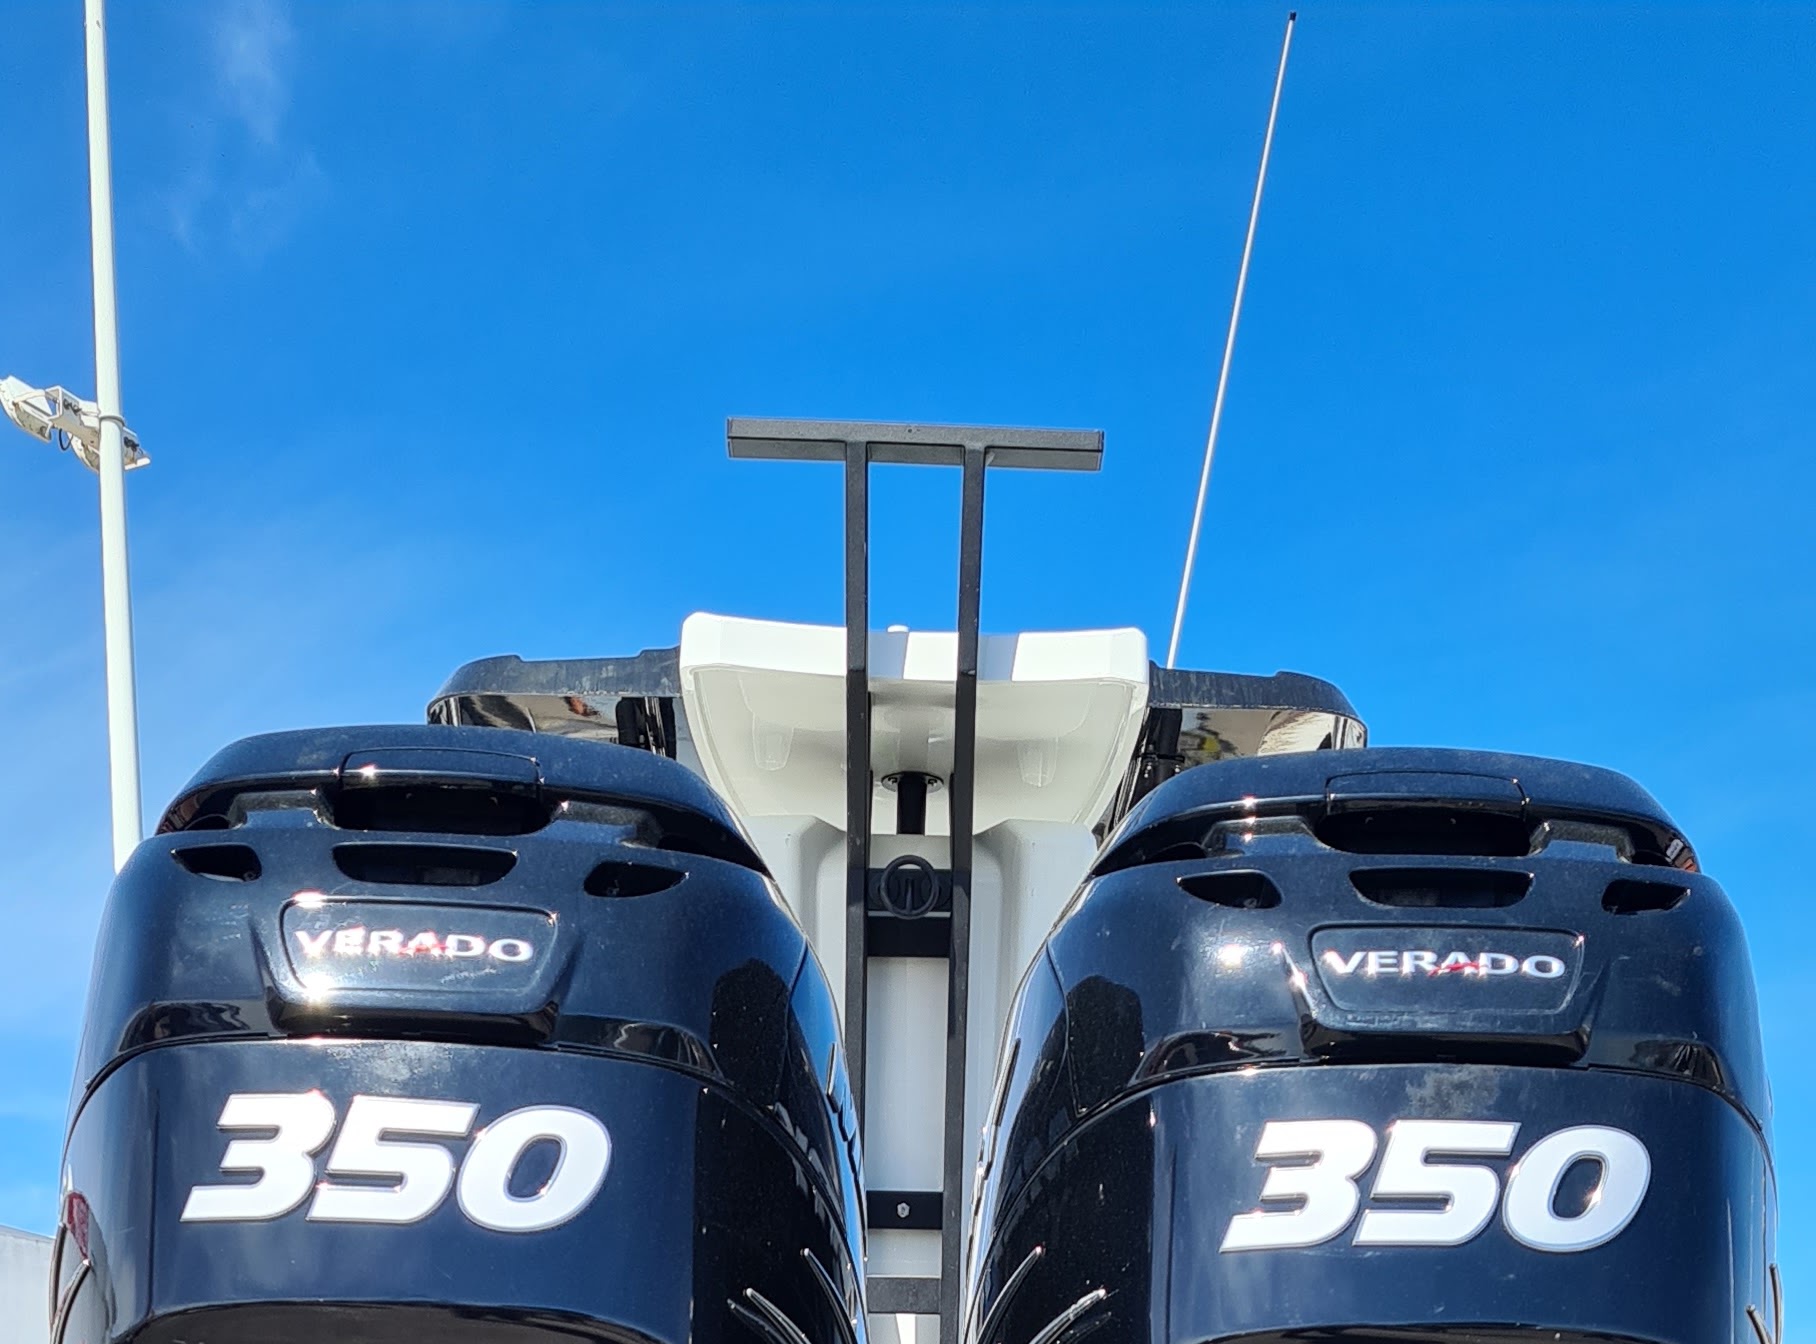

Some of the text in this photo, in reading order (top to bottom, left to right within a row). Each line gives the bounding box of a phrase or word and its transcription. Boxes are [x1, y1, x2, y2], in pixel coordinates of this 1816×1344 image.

[294, 926, 534, 963] VERADO
[1323, 949, 1566, 979] VERADO
[179, 1090, 613, 1234] 350
[1219, 1119, 1652, 1254] 350
